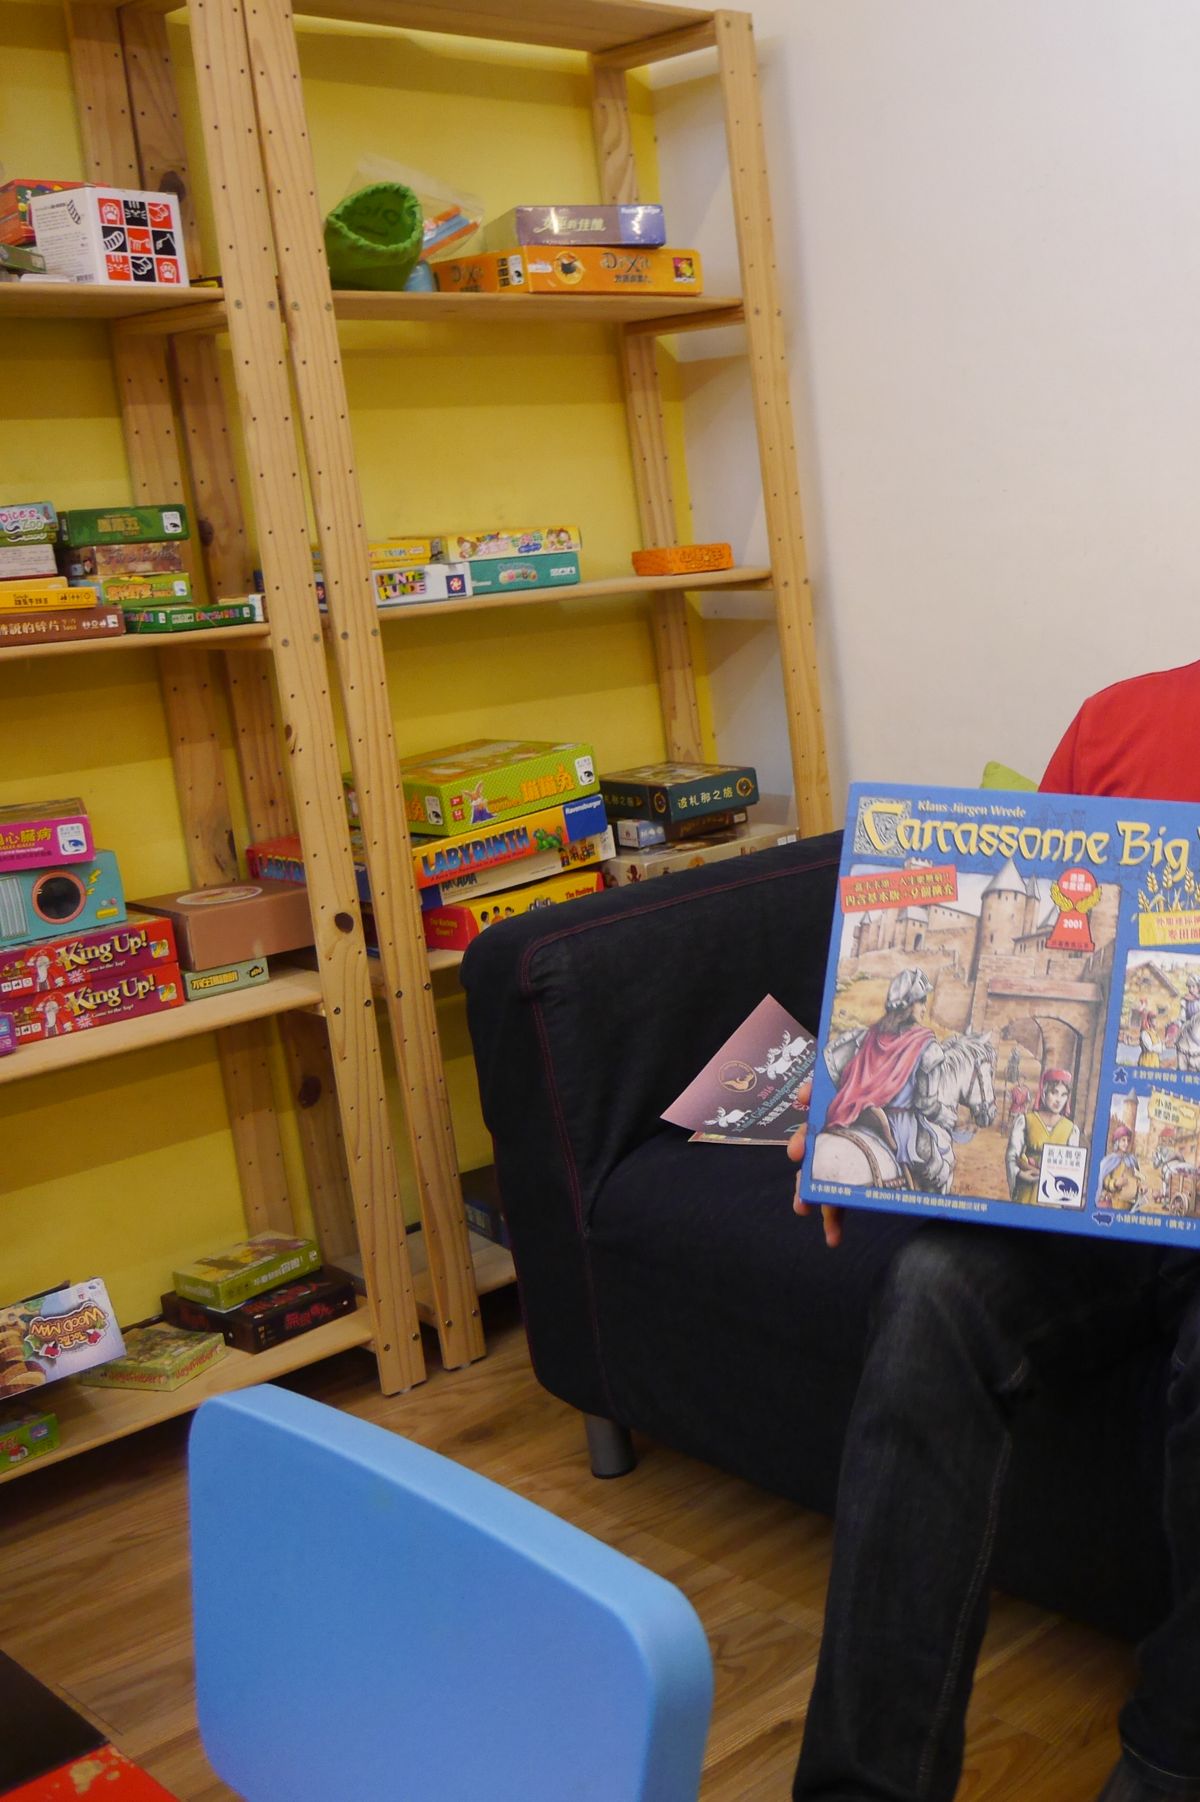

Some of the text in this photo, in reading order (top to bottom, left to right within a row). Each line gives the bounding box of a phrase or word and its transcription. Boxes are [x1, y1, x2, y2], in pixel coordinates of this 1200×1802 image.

[990, 804, 1026, 818] Wrede
[421, 825, 531, 878] LABYRINTH
[862, 802, 1110, 865] Carcassonne
[1116, 820, 1190, 883] Big
[1062, 919, 1083, 930] 2001
[56, 930, 148, 973] King Up!
[64, 974, 156, 1018] King Up!
